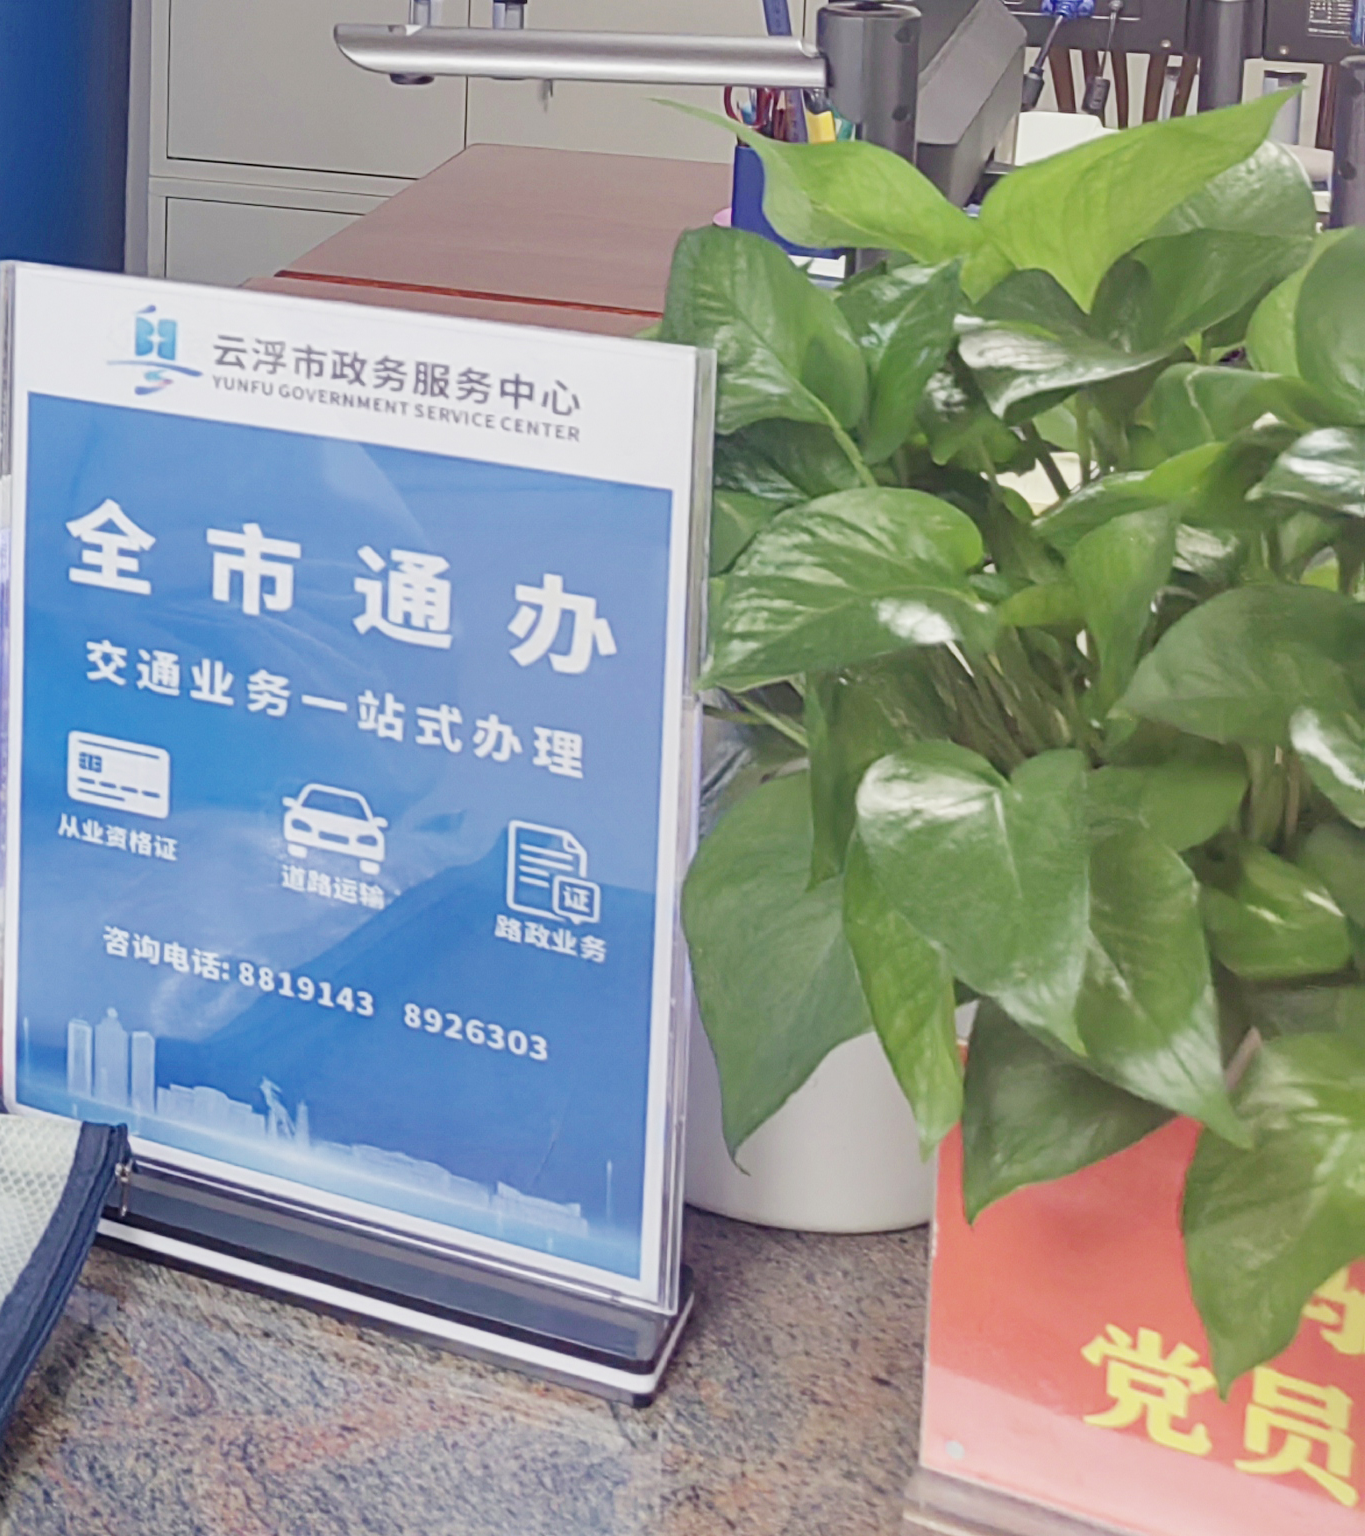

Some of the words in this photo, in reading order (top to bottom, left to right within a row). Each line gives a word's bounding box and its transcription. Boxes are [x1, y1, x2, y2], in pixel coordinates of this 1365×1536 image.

[212, 334, 581, 417] 云浮市政务服务中心
[212, 374, 274, 396] YUNFU
[278, 383, 409, 416] GOVERNMENT
[414, 403, 495, 430] SERVICE
[500, 416, 580, 442] CENTER
[66, 499, 617, 675] 全市通办
[85, 640, 584, 779] 交通业务一站式办理
[57, 814, 178, 862] 从业资格证
[281, 865, 385, 910] 道路运输
[563, 886, 591, 914] 证
[494, 914, 608, 962] 路政业务
[238, 962, 374, 1017] 8819143
[403, 1004, 549, 1061] 8926303
[1081, 1324, 1359, 1507] 党员
